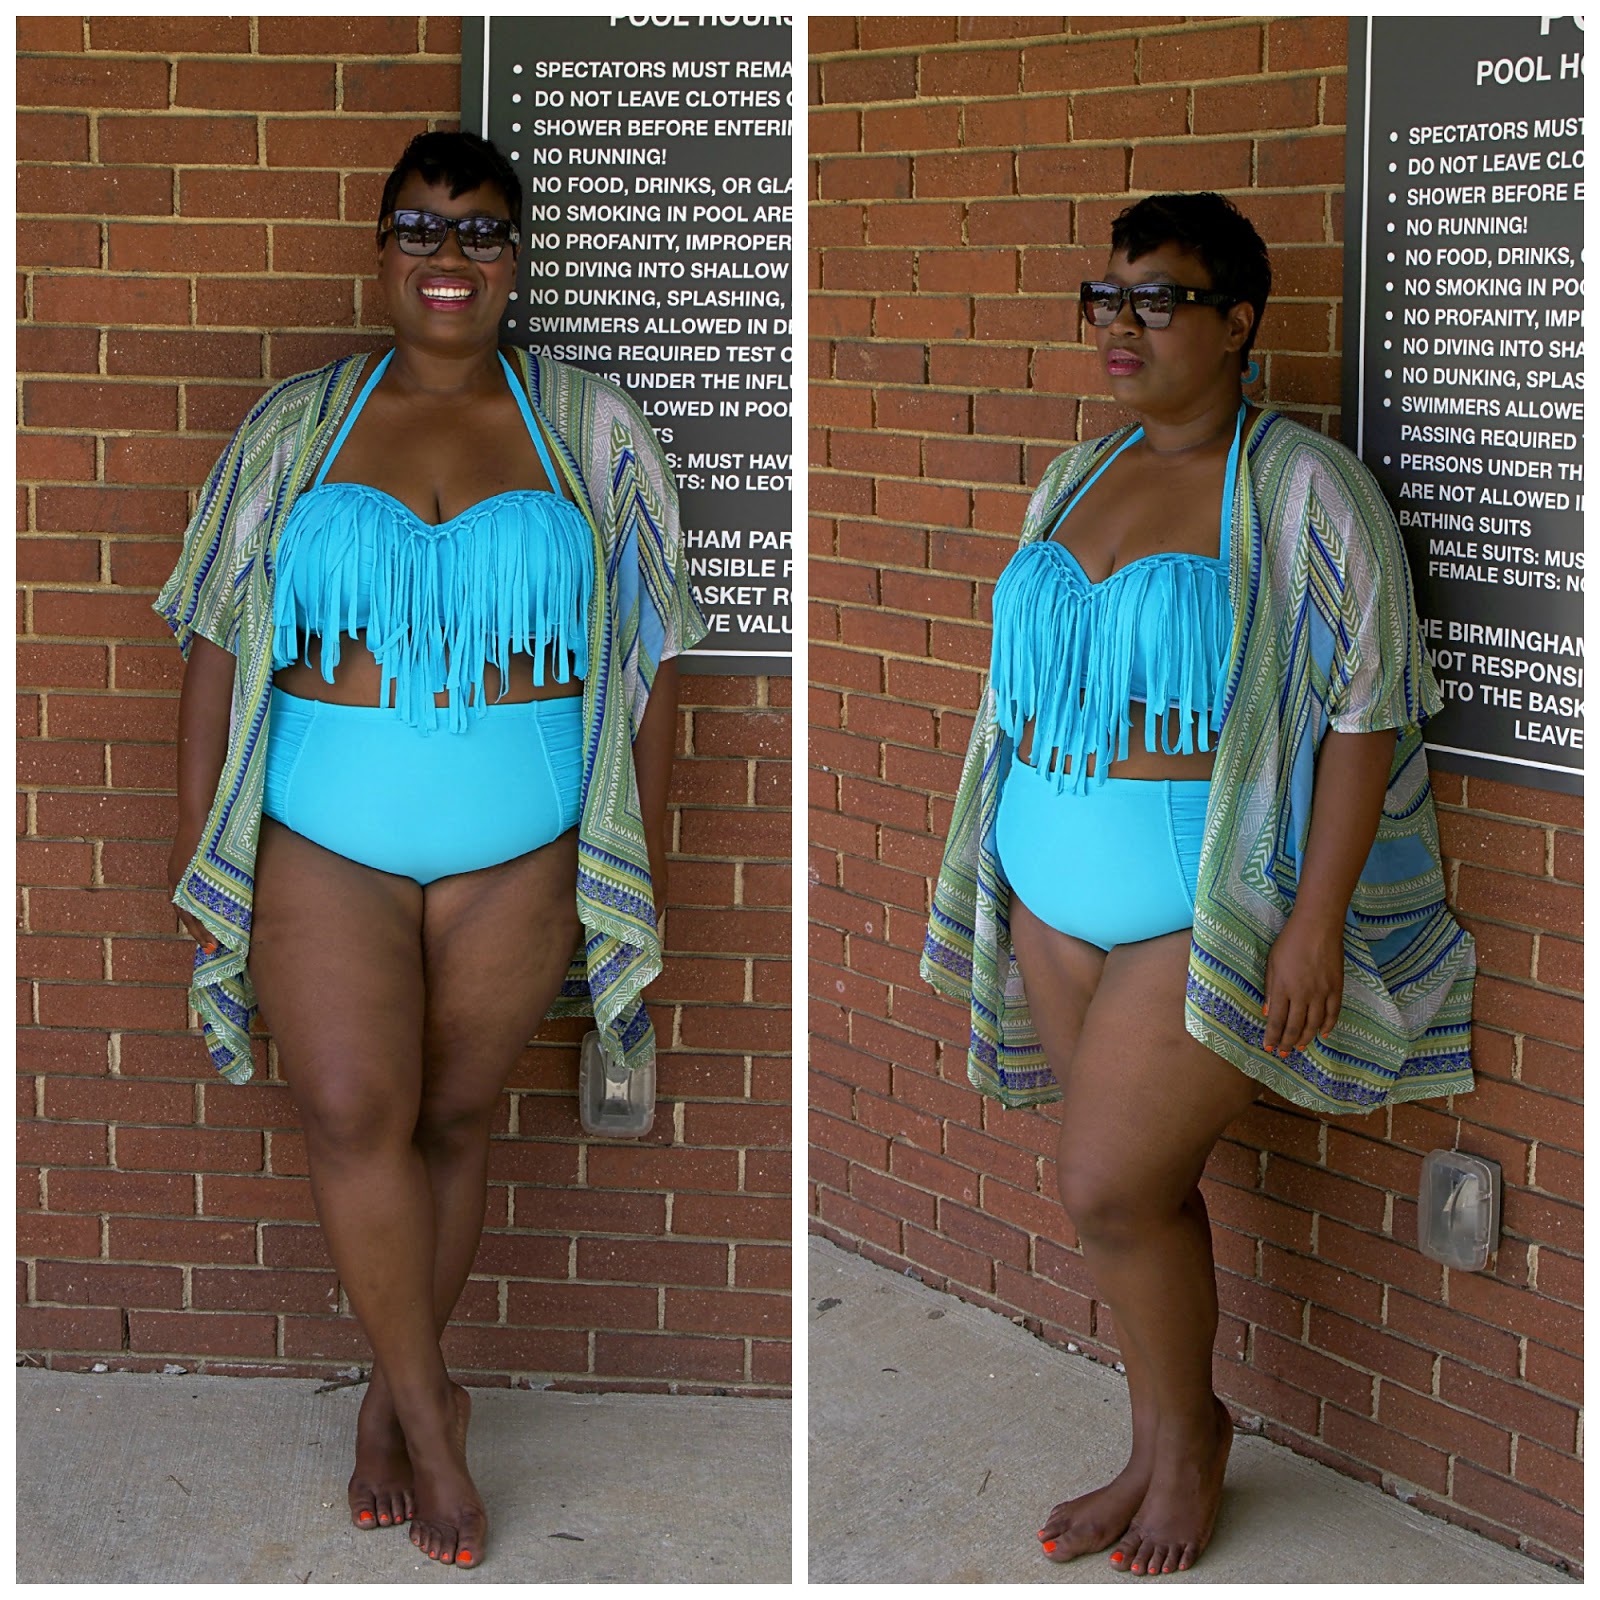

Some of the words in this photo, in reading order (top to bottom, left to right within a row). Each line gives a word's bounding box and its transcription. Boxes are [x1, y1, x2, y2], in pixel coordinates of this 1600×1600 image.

[535, 61, 666, 78] SPECTATORS
[672, 61, 729, 78] MUST
[1476, 56, 1550, 85] POOL
[535, 91, 564, 107] DO
[570, 91, 612, 107] NOT
[618, 91, 679, 107] LEAVE
[686, 91, 780, 108] CLOTHES
[533, 120, 621, 136] SHOWER
[628, 120, 708, 136] BEFORE
[1408, 121, 1528, 144] SPECTATORS
[533, 148, 562, 165] NO
[569, 149, 667, 165] RUNNING!
[1408, 158, 1435, 175] DO
[1440, 155, 1478, 174] NOT
[1483, 152, 1541, 172] LEAVE
[532, 177, 562, 193] NO
[568, 177, 628, 196] FOOD,
[635, 177, 716, 196] DRINKS,
[722, 177, 751, 194] OR
[1407, 187, 1486, 205] SHOWER
[1492, 184, 1567, 203] BEFORE
[532, 205, 560, 221] NO
[566, 205, 661, 222] SMOKING
[667, 206, 687, 222] IN
[693, 206, 748, 222] POOL
[1407, 219, 1432, 236] NO
[1438, 216, 1528, 235] RUNNING!
[531, 234, 560, 250] NO
[566, 234, 680, 252] PROFANITY,
[686, 234, 791, 251] IMPROPER
[1405, 249, 1431, 266] NO
[1437, 248, 1492, 269] FOOD,
[1498, 247, 1574, 268] DRINKS,
[530, 261, 559, 277] NO
[566, 261, 632, 278] DIVING
[638, 262, 684, 278] INTO
[690, 262, 789, 279] SHALLOW
[1404, 278, 1431, 296] NO
[1435, 278, 1522, 296] SMOKING
[1528, 278, 1546, 296] IN
[530, 289, 559, 305] NO
[565, 289, 661, 308] DUNKING,
[667, 290, 785, 309] SPLASHING,
[529, 317, 639, 333] SWIMMERS
[644, 318, 741, 334] ALLOWED
[748, 318, 767, 335] IN
[1404, 309, 1429, 325] NO
[1435, 309, 1539, 330] PROFANITY,
[529, 346, 612, 361] PASSING
[618, 346, 721, 362] REQUIRED
[726, 346, 776, 362] TEST
[1403, 338, 1429, 355] NO
[1434, 338, 1494, 357] DIVING
[1500, 340, 1543, 358] INTO
[627, 373, 695, 389] UNDER
[701, 374, 739, 389] THE
[1402, 368, 1428, 384] NO
[1433, 368, 1521, 390] DUNKING,
[720, 402, 740, 416] IN
[1401, 396, 1500, 417] SWIMMERS
[1401, 425, 1475, 445] PASSING
[1481, 428, 1577, 450] REQUIRED
[688, 454, 743, 469] MUST
[1400, 453, 1482, 475] PERSONS
[1488, 457, 1552, 479] UNDER
[711, 475, 740, 490] NO
[1400, 482, 1434, 500] ARE
[1439, 485, 1475, 503] NOT
[1480, 488, 1570, 511] ALLOWED
[1399, 510, 1474, 532] BATHING
[1479, 516, 1532, 537] SUITS
[1429, 539, 1477, 559] MALE
[1482, 544, 1539, 565] SUITS:
[1429, 561, 1498, 583] FEMALE
[1503, 569, 1561, 590] SUITS:
[1479, 685, 1522, 709] THE
[1515, 720, 1583, 749] LEAVE
